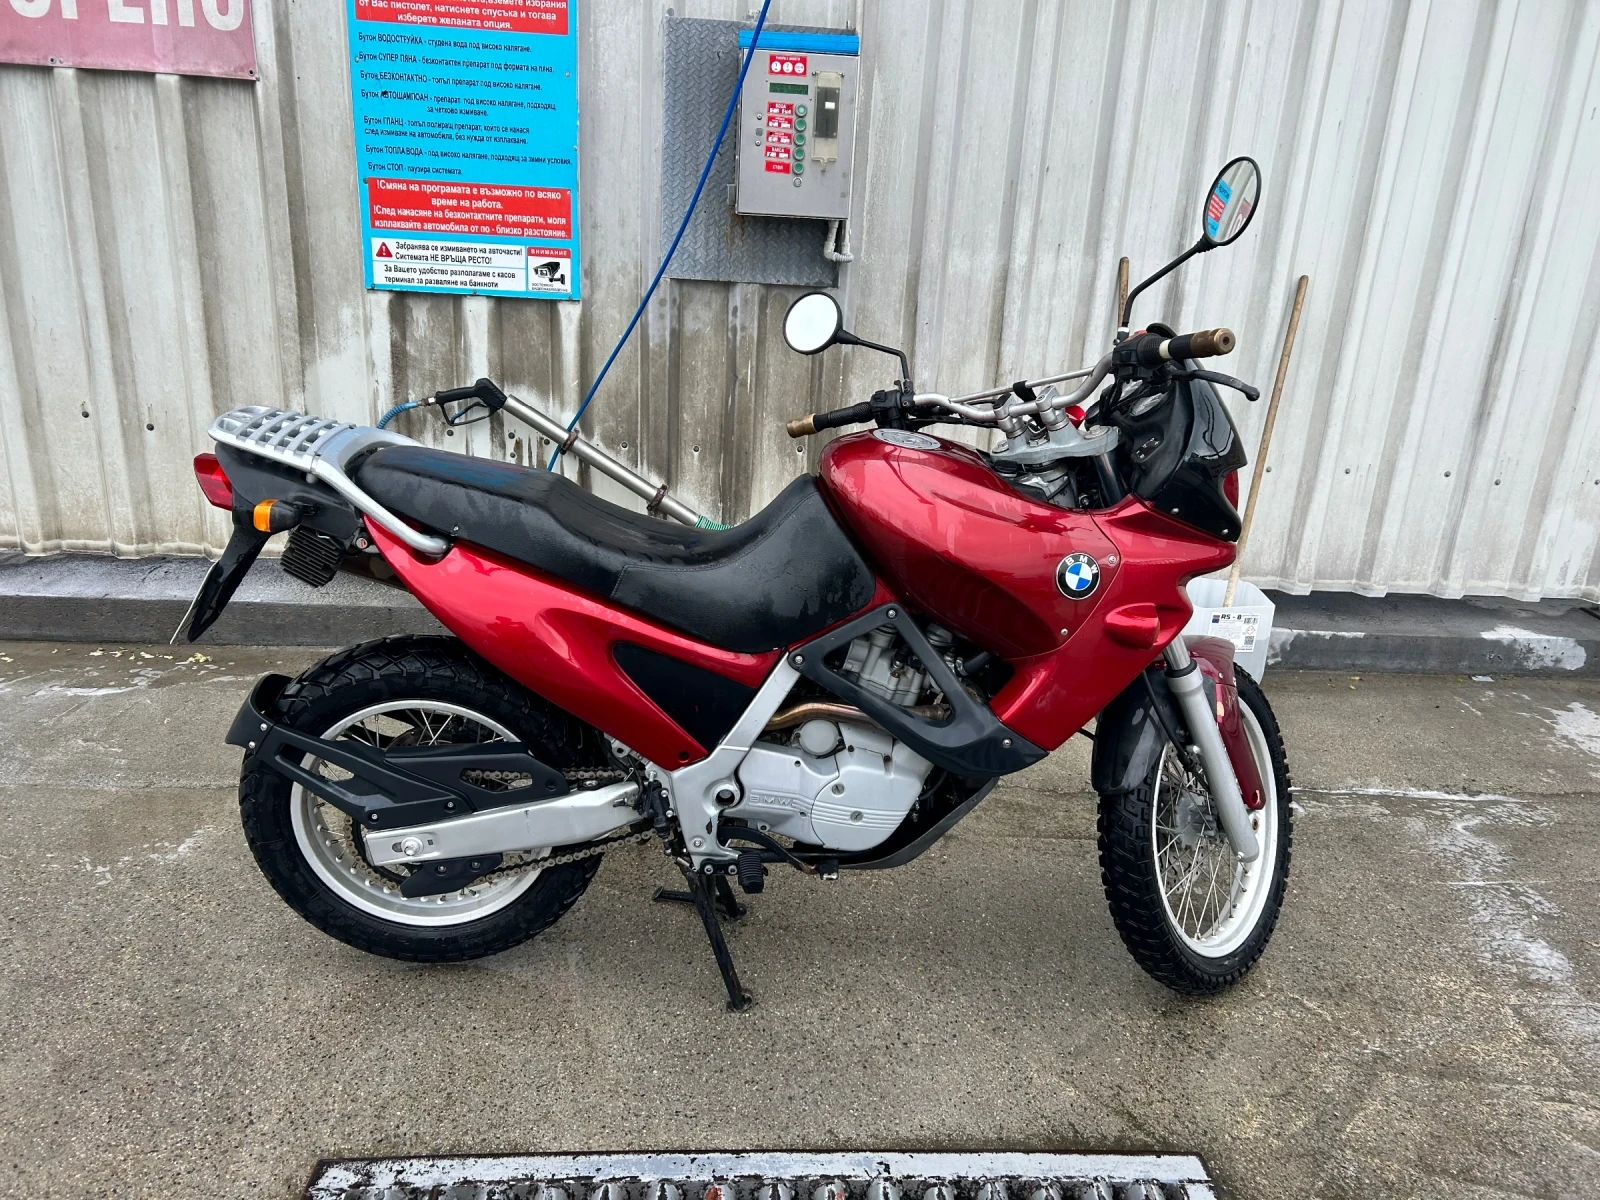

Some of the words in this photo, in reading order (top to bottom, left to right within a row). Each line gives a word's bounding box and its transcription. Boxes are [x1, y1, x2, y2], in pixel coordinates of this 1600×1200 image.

[391, 2, 432, 12] пистолет,
[435, 5, 479, 14] натиснете
[482, 8, 518, 18] спусъка
[528, 11, 556, 20] тогава
[397, 13, 436, 24] изберете
[440, 16, 481, 26] желаната
[484, 21, 512, 29] опция.
[358, 32, 376, 42] Бутон
[428, 39, 452, 48] студена
[469, 42, 480, 50] под
[504, 44, 531, 53] налягане.
[359, 51, 377, 61] Бутон
[379, 53, 398, 61] СУПЕР
[422, 56, 460, 67] безконтактен
[462, 60, 489, 69] препарат
[504, 62, 529, 73] формата
[360, 70, 378, 80] Бутон
[380, 72, 427, 82] БЕЗКОНТАКТНО
[452, 79, 479, 88] препарат
[361, 89, 378, 99] Бутон
[434, 95, 460, 104] препарат
[498, 100, 525, 108] налягане,
[527, 102, 556, 110] подходящ
[364, 116, 381, 125] Бутон
[383, 117, 403, 127] ГЛАНЦ
[427, 121, 453, 130] полиращ
[455, 122, 482, 132] препарат,
[484, 123, 500, 131] който
[418, 132, 454, 141] автомобила,
[456, 132, 465, 140] без
[494, 136, 528, 145] изплакване.
[366, 145, 383, 154] Бутон
[385, 146, 405, 155] ТОПЛА
[406, 147, 423, 157] ВОДА
[462, 151, 489, 160] налягане,
[491, 154, 519, 163] подходящ
[548, 157, 572, 165] условия.
[368, 162, 385, 171] Бутон
[408, 166, 430, 174] паузира
[432, 167, 463, 175] системата.
[377, 179, 407, 191] !Смяна
[422, 184, 470, 195] програмата
[480, 188, 522, 197] възможно
[537, 191, 561, 199] всяко
[431, 197, 457, 207] време
[472, 199, 503, 210] работа.
[374, 205, 396, 216] !След
[397, 208, 432, 217] нанасяне
[445, 209, 502, 220] безконтактните
[505, 214, 545, 225] препарати,
[375, 219, 421, 230] изплаквайте
[424, 222, 468, 232] автомобила
[496, 224, 522, 234] близко
[524, 228, 567, 238] разстояние.
[396, 241, 429, 252] Забранява
[440, 244, 477, 253] измиването
[488, 247, 522, 256] авточасти!
[395, 252, 428, 262] Системата
[430, 254, 439, 262] НЕ
[441, 254, 466, 264] ВРЪЩА
[468, 255, 492, 265] РЕСТО!
[384, 264, 392, 272] За
[418, 266, 448, 276] удобство
[498, 271, 515, 279] касов
[385, 276, 415, 284] терминал
[425, 278, 458, 287] разваляне
[469, 279, 498, 288] банкноти
[1066, 555, 1098, 574] BMW
[750, 795, 791, 805] BMW
